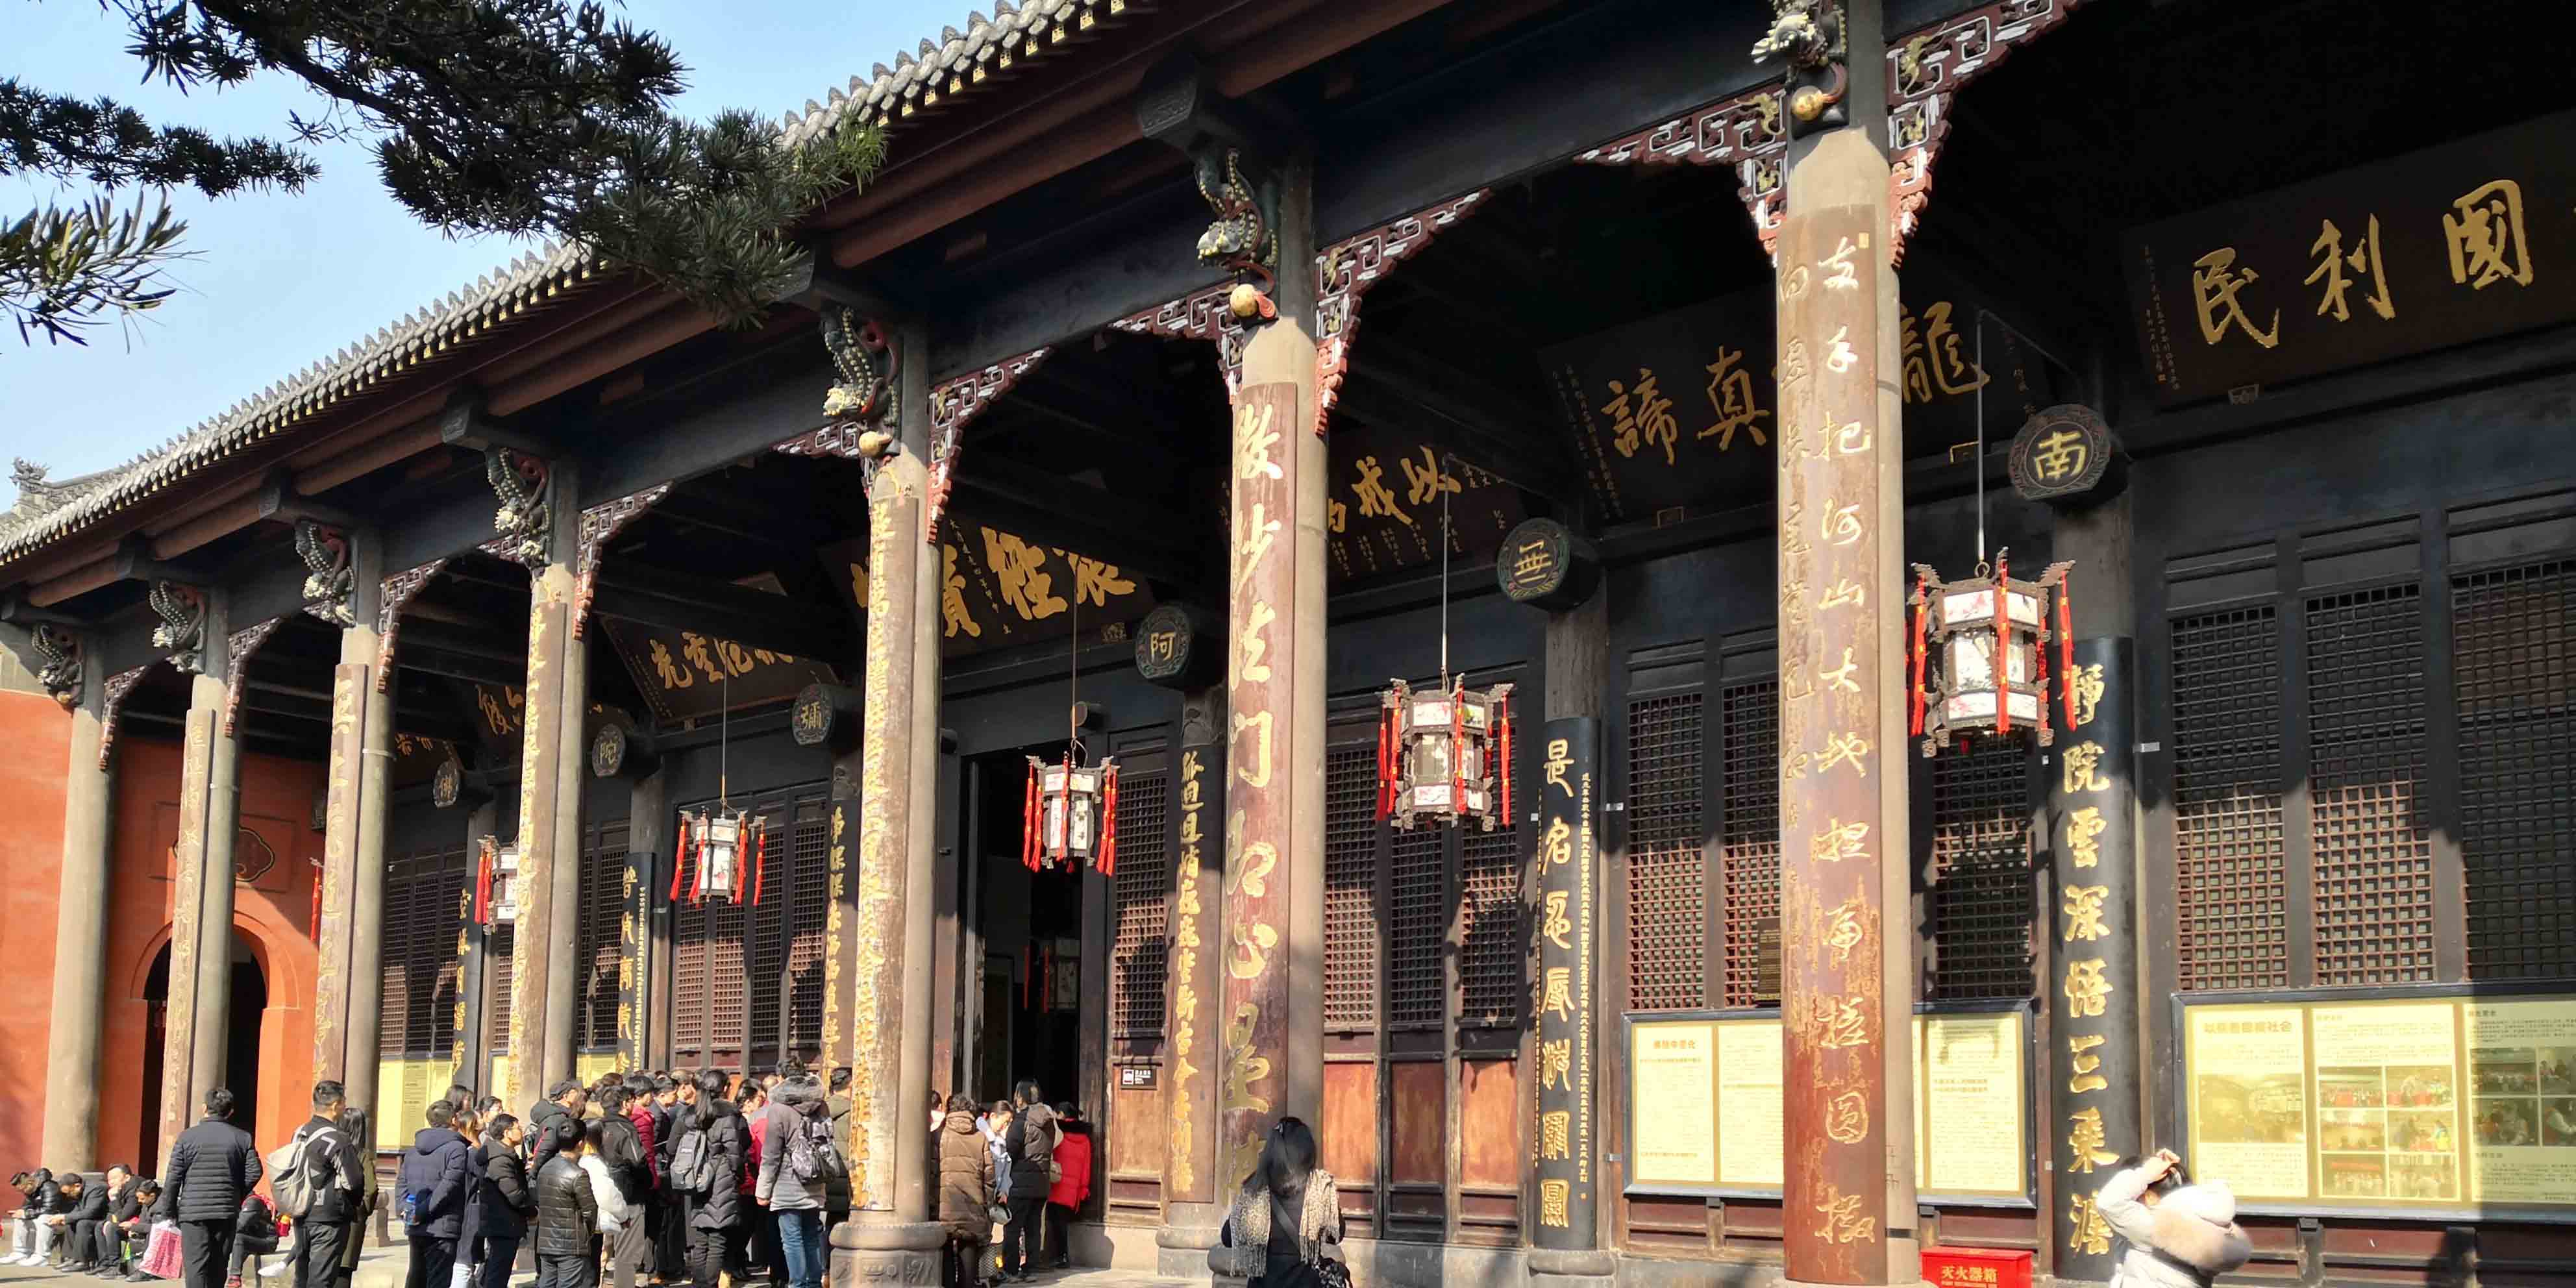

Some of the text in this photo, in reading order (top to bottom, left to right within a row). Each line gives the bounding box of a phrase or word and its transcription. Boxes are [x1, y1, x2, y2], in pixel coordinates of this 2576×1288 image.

[2193, 180, 2576, 348] 國利民
[2033, 430, 2087, 482] 南
[1150, 632, 1178, 661] 阿
[1942, 1266, 1998, 1283] 灭火器箱
